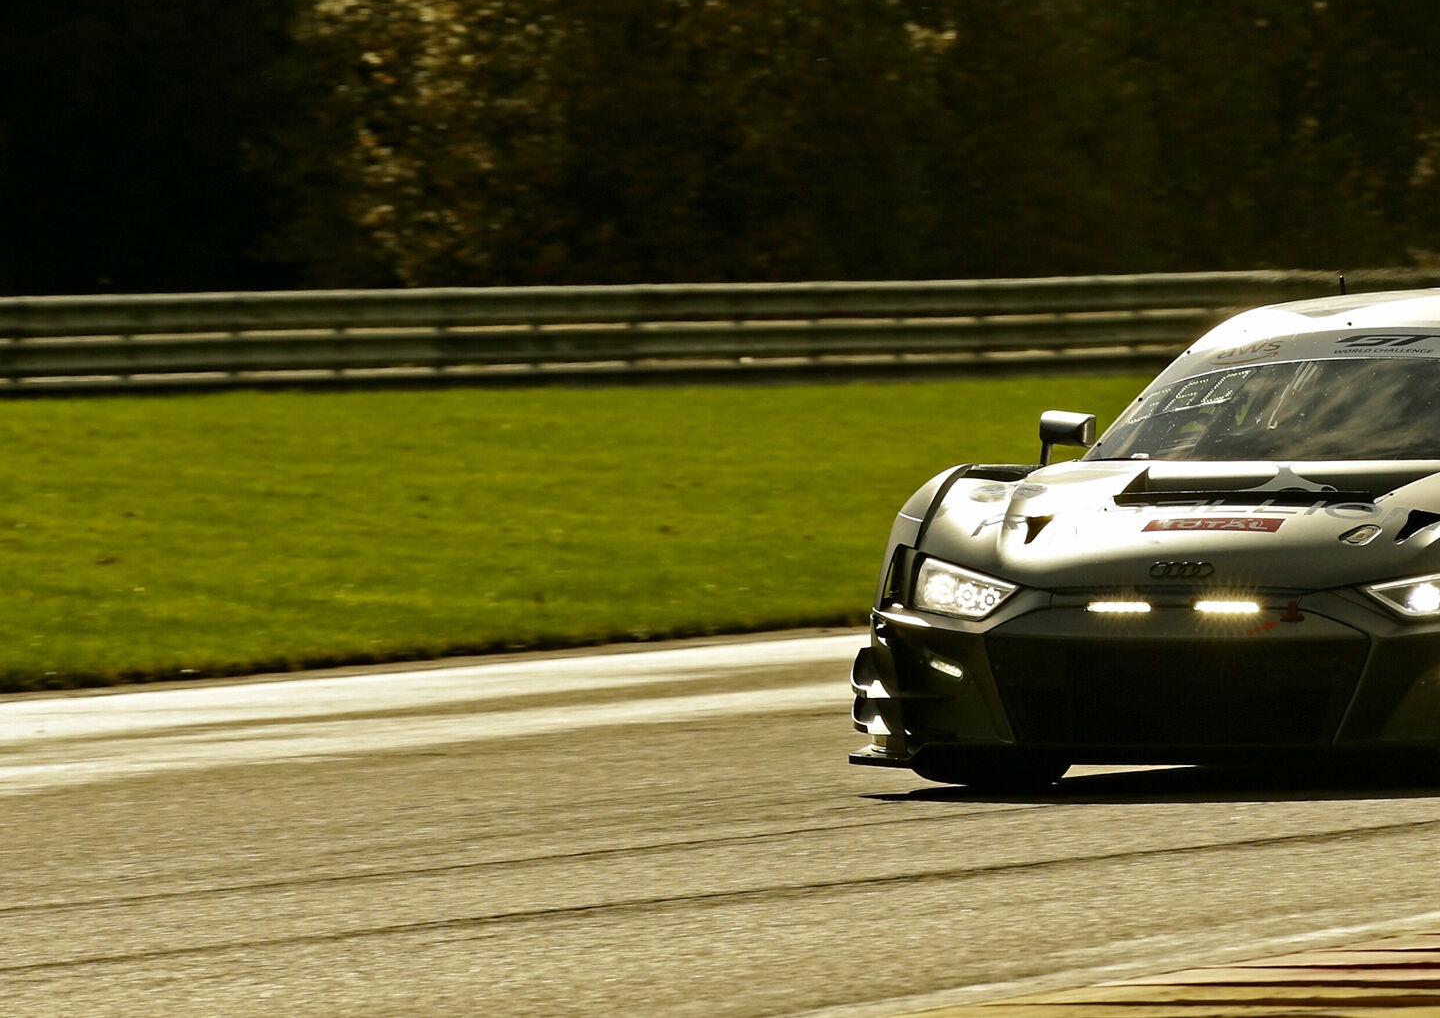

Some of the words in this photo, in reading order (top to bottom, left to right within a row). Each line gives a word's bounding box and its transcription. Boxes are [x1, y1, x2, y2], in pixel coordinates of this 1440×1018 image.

[1334, 347, 1374, 355] WORLD
[1374, 347, 1434, 355] CHALLENGE
[1158, 519, 1268, 531] TOTAL
